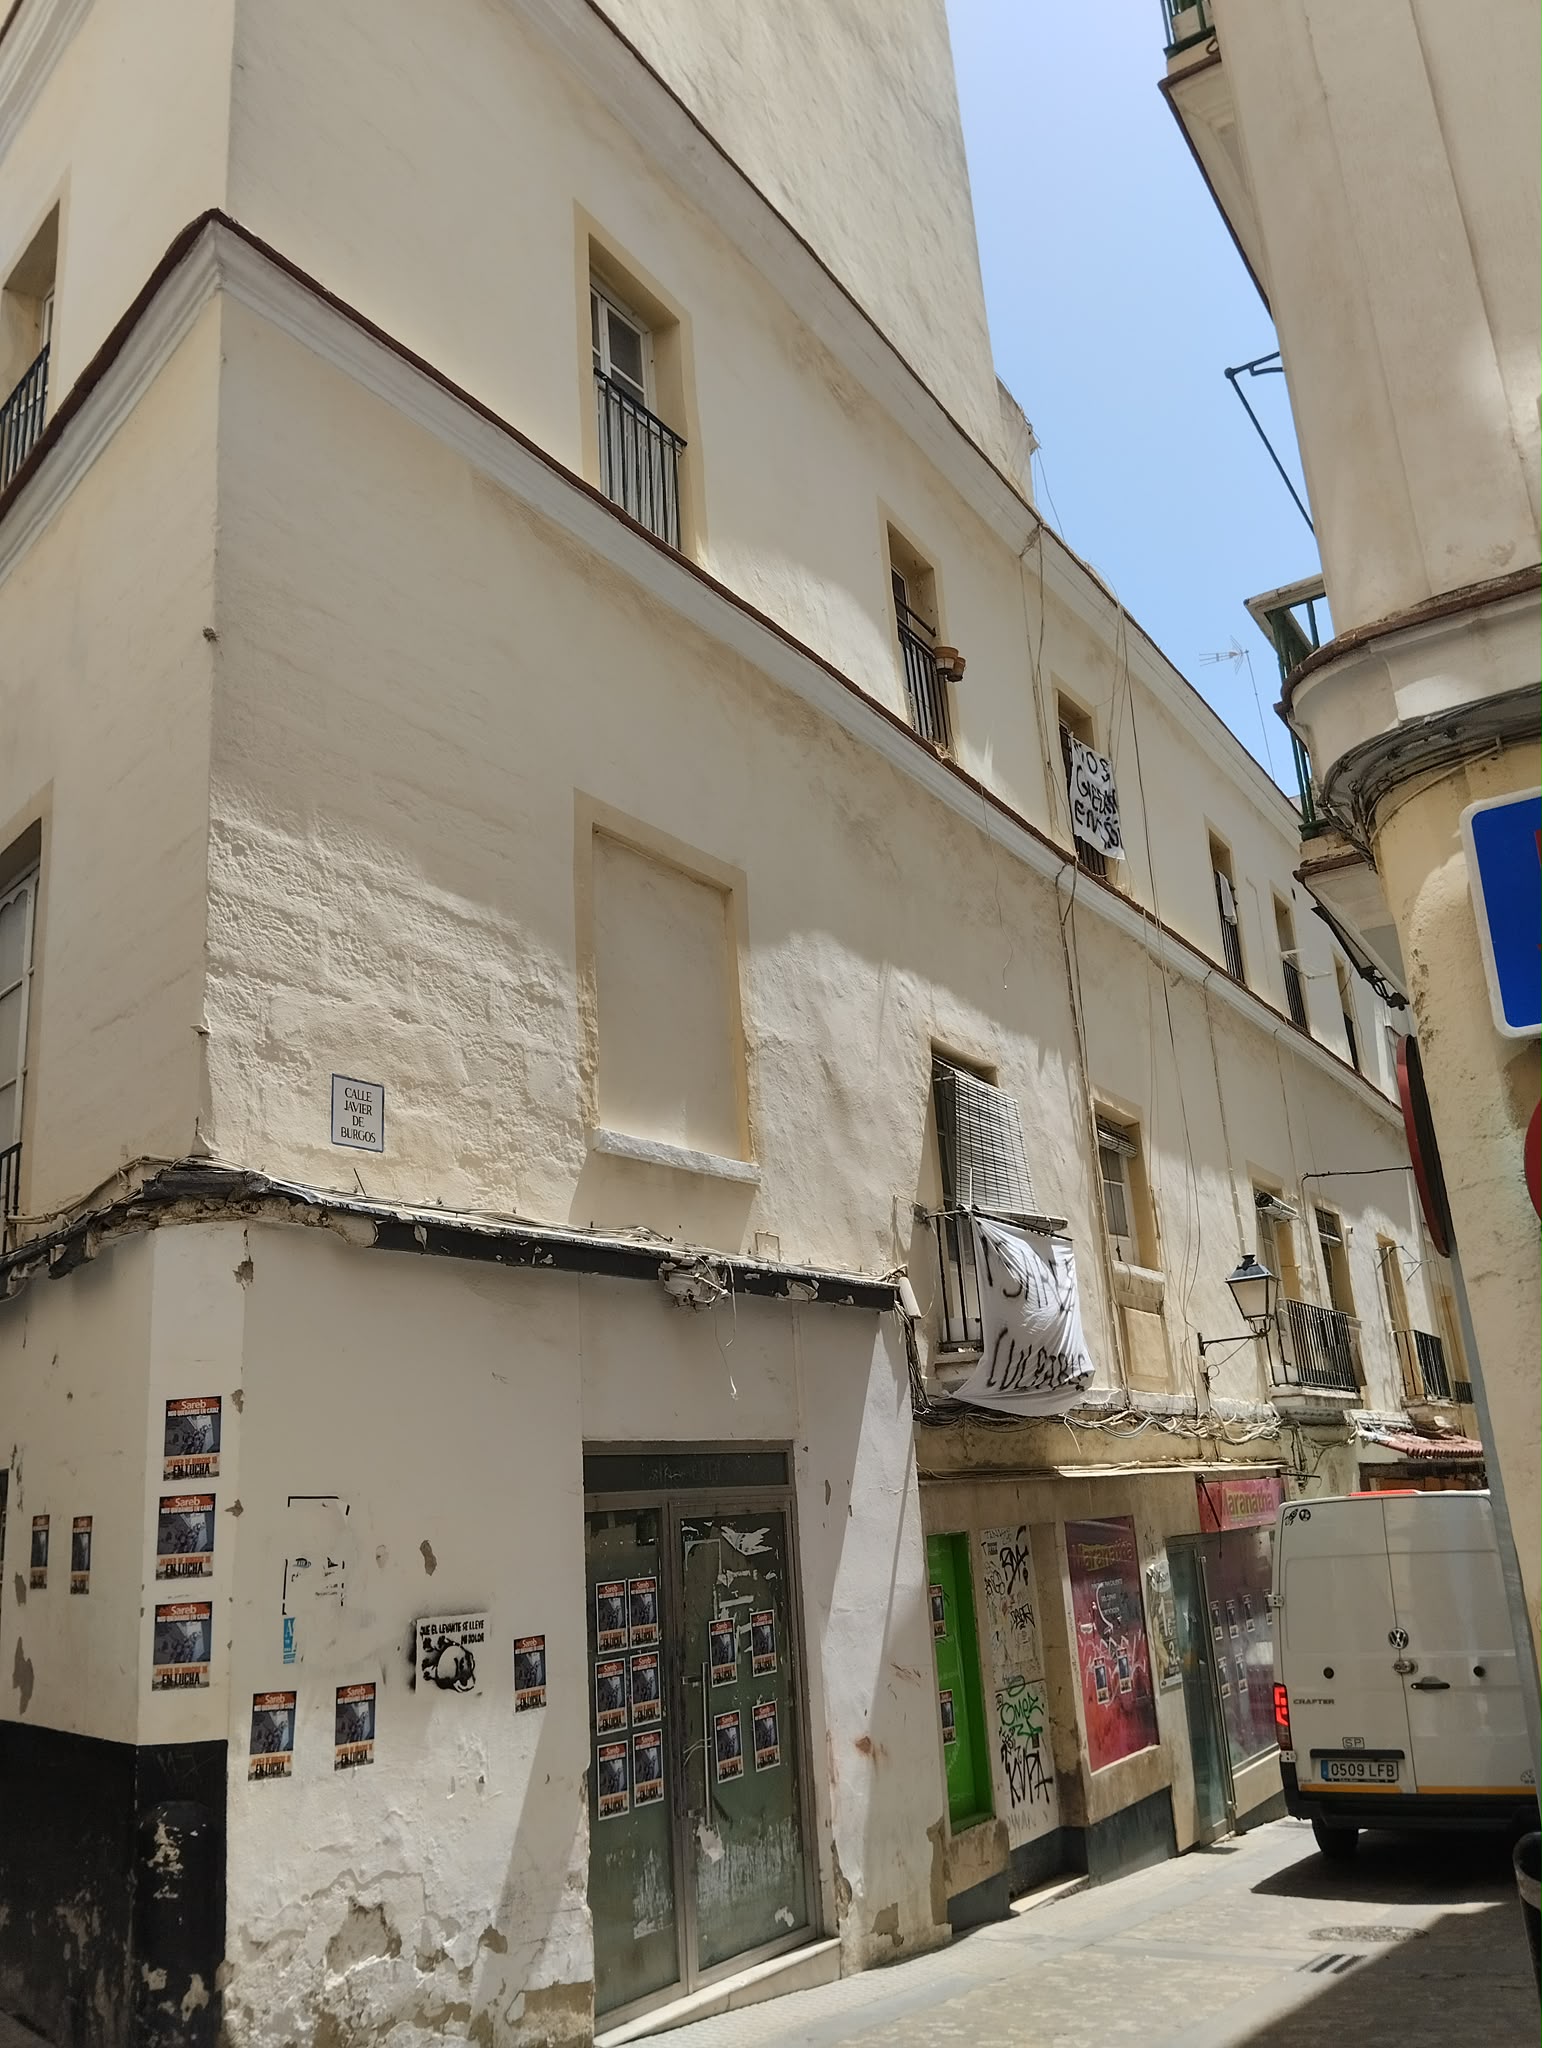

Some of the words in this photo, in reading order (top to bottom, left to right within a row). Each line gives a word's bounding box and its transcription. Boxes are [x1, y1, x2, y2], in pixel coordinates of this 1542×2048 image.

[344, 1087, 373, 1103] CALLE
[344, 1100, 373, 1116] JAVIER
[352, 1115, 365, 1127] DE
[340, 1126, 376, 1143] BURGOS
[181, 1399, 207, 1410] Sareb
[175, 1496, 201, 1507] Sareb
[171, 1605, 197, 1616] Sareb
[438, 1622, 462, 1634] LEVANTE
[1344, 1738, 1362, 1748] SP
[1331, 1762, 1365, 1778] 0509
[1368, 1763, 1395, 1778] LFB
